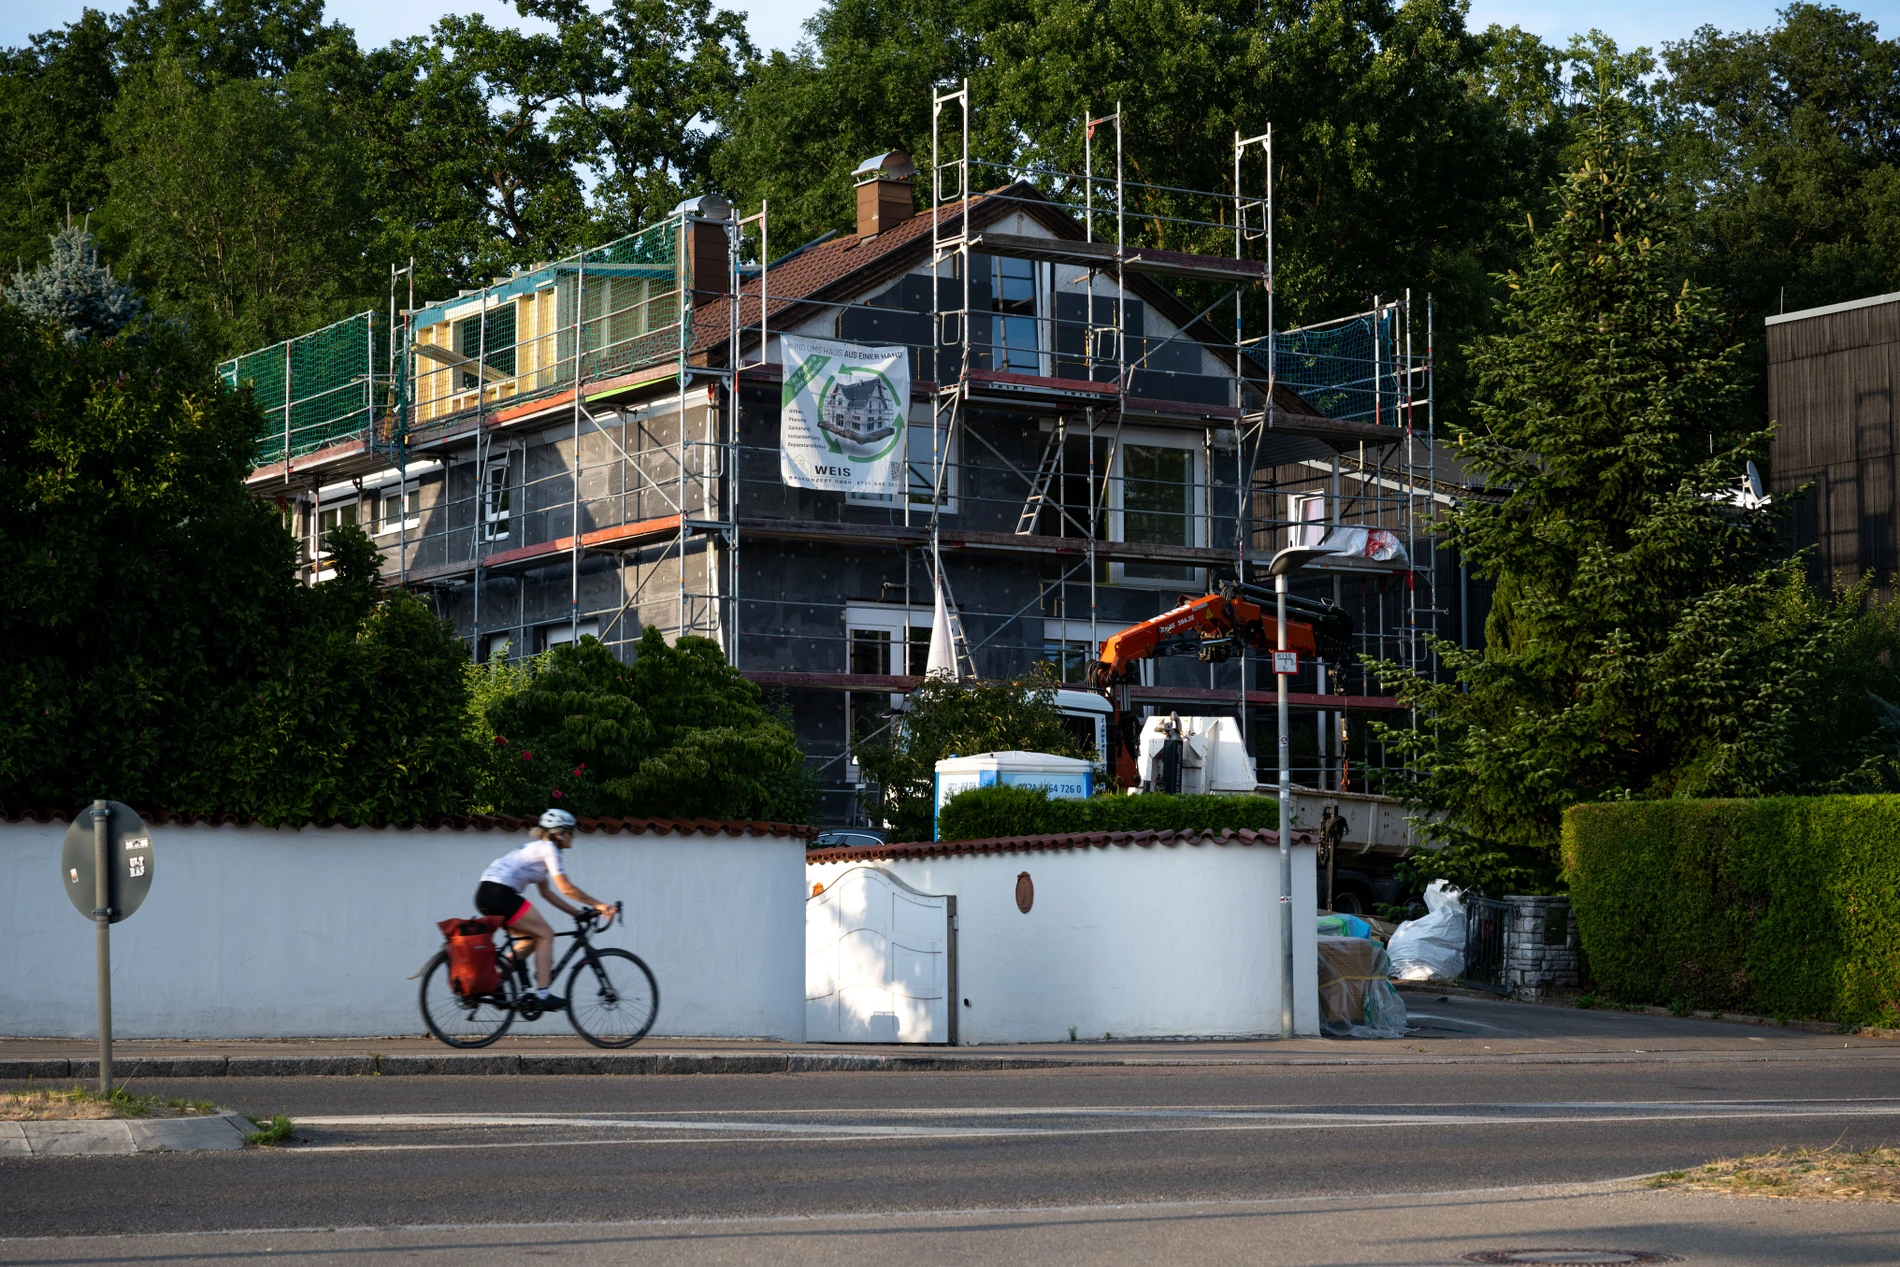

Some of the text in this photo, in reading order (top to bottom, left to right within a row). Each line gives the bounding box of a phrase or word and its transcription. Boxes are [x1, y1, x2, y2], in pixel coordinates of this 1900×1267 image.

[788, 341, 903, 360] RUND UMS HAUS AUS EINER HAND
[815, 465, 851, 477] WEIS
[1060, 784, 1075, 794] 726
[1076, 784, 1082, 794] 0
